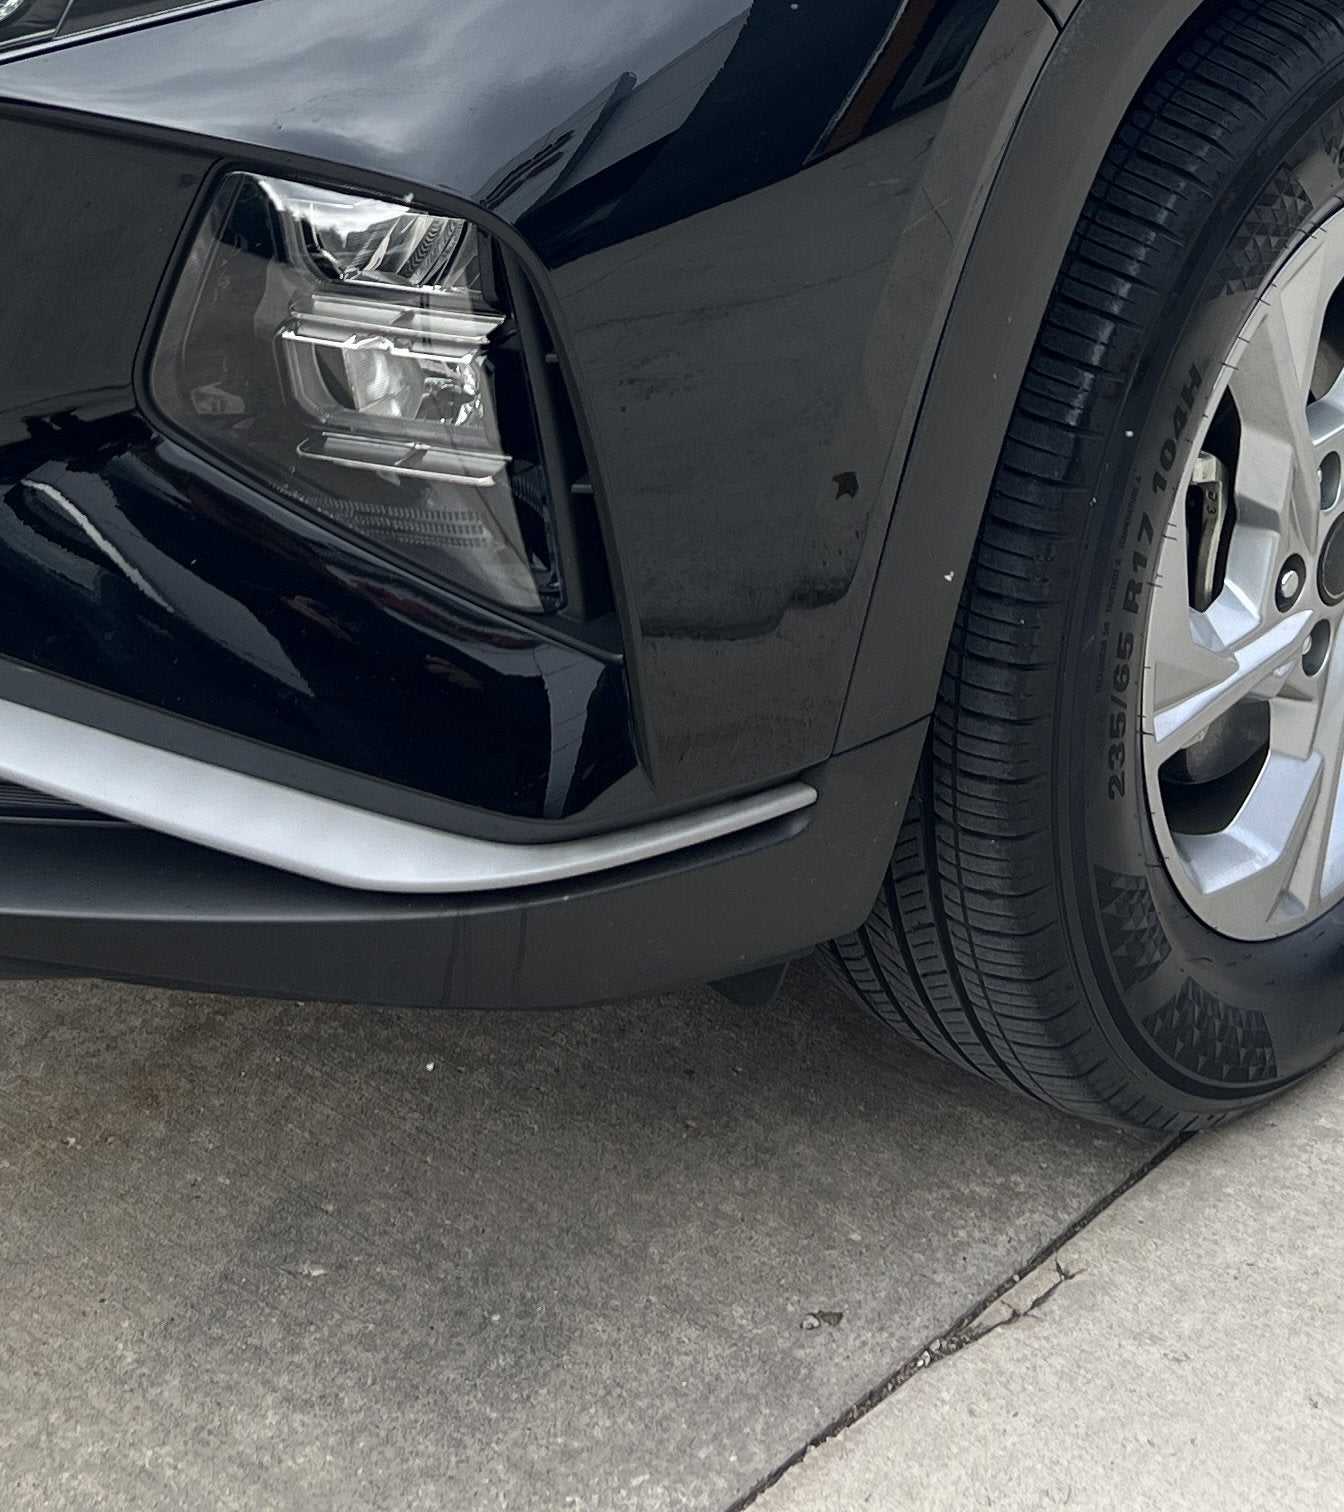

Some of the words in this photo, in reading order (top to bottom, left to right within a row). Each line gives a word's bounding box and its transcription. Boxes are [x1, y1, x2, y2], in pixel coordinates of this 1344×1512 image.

[1108, 631, 1135, 801] 235/65
[1123, 512, 1154, 615] R17
[1152, 363, 1203, 493] 104H
